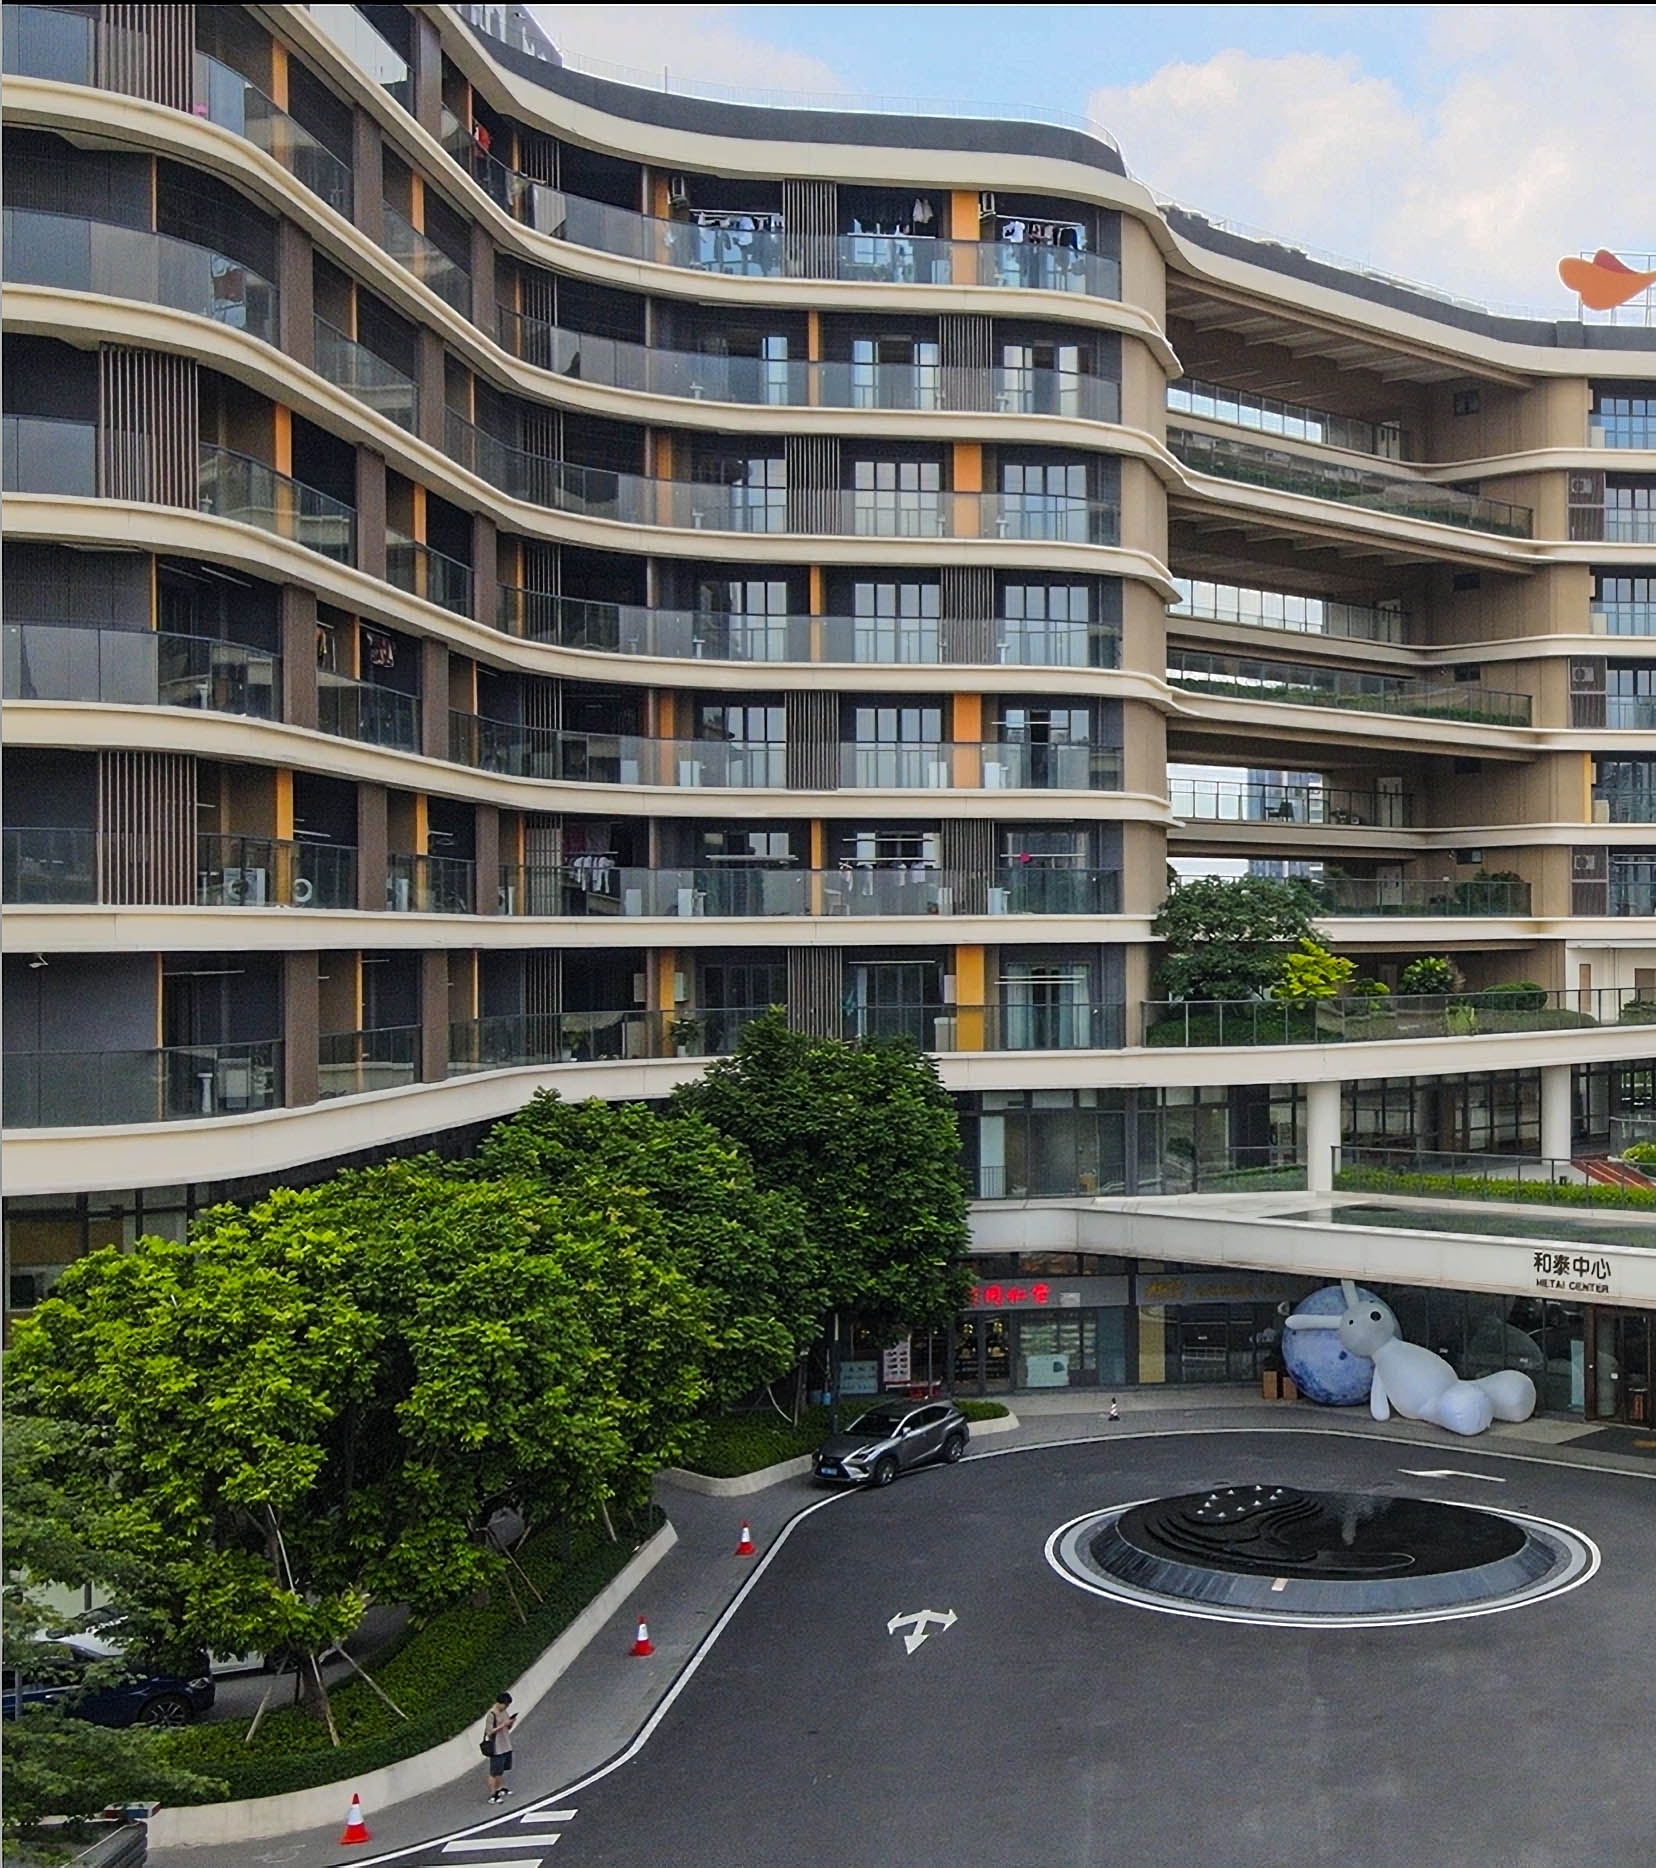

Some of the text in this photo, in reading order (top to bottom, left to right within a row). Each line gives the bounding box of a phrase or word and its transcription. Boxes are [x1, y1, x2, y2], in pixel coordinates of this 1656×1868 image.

[1533, 1251, 1612, 1280] 和泰中心
[1536, 1278, 1609, 1294] HETAI CENTER
